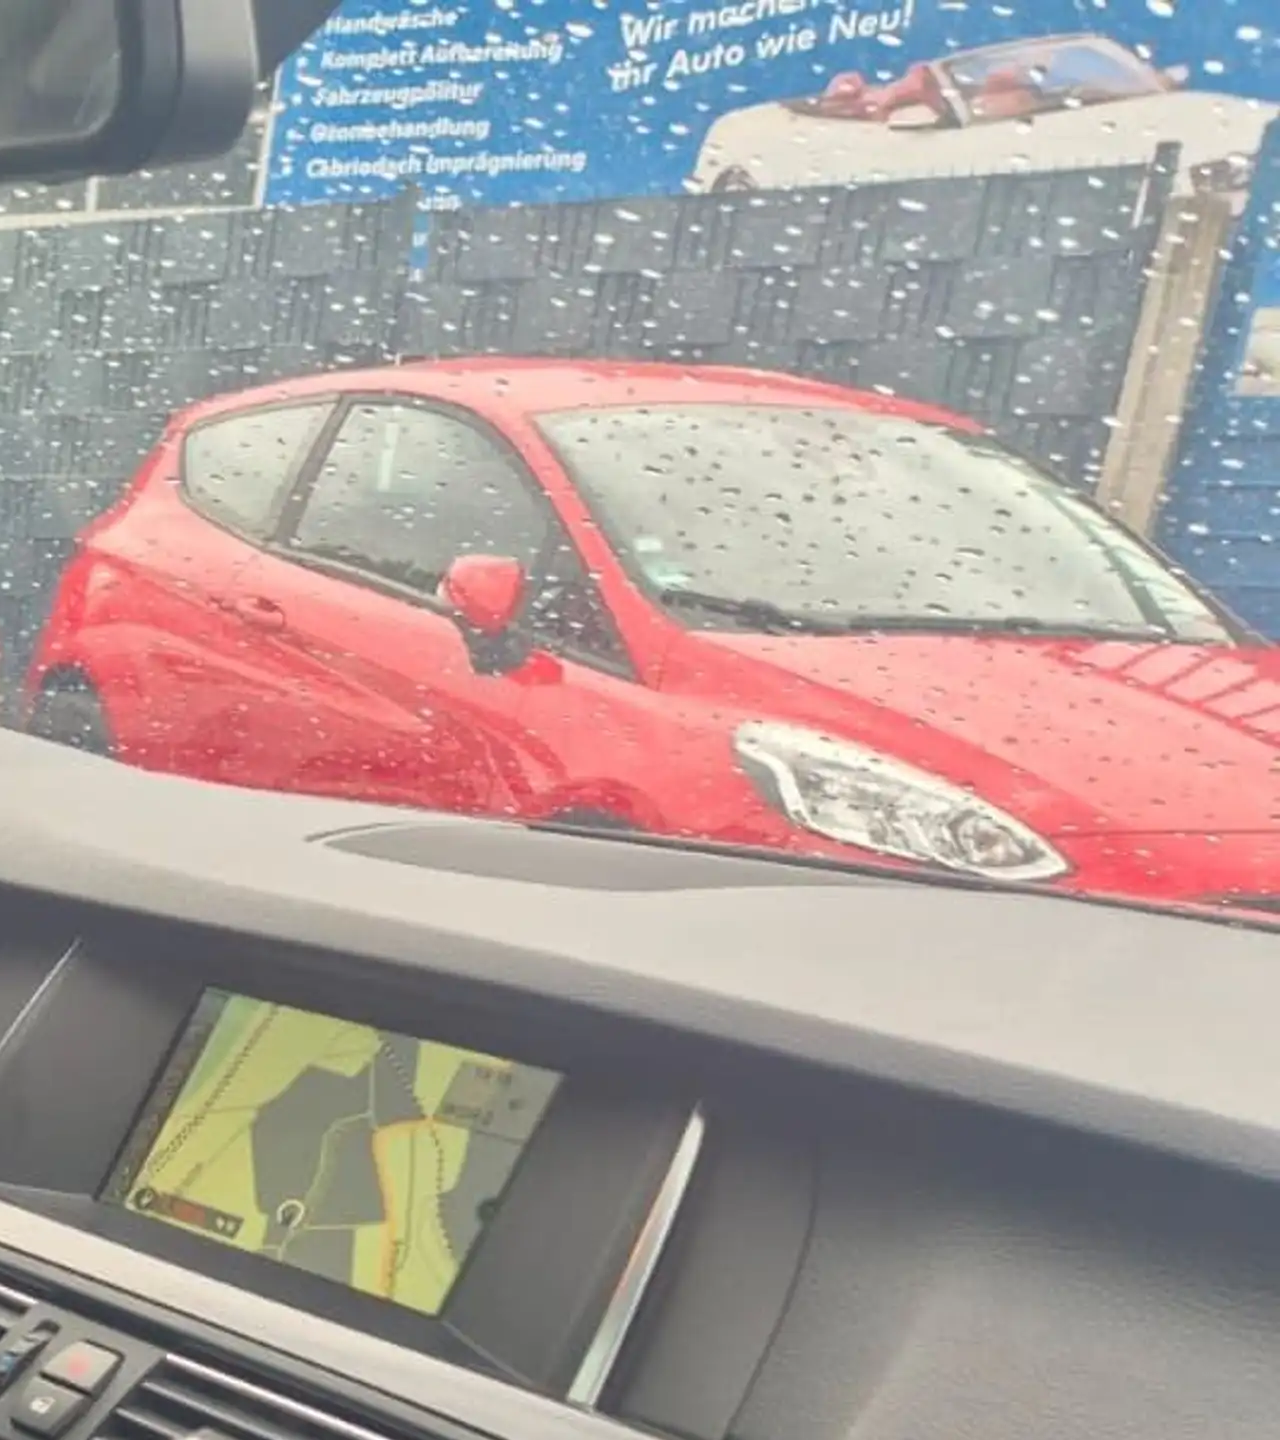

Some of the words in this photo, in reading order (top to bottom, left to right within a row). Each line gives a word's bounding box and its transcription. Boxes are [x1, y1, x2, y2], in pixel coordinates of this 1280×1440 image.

[620, 12, 678, 47] Wir
[664, 43, 745, 78] Auto
[756, 23, 817, 58] wie
[828, 0, 915, 44] Neu!
